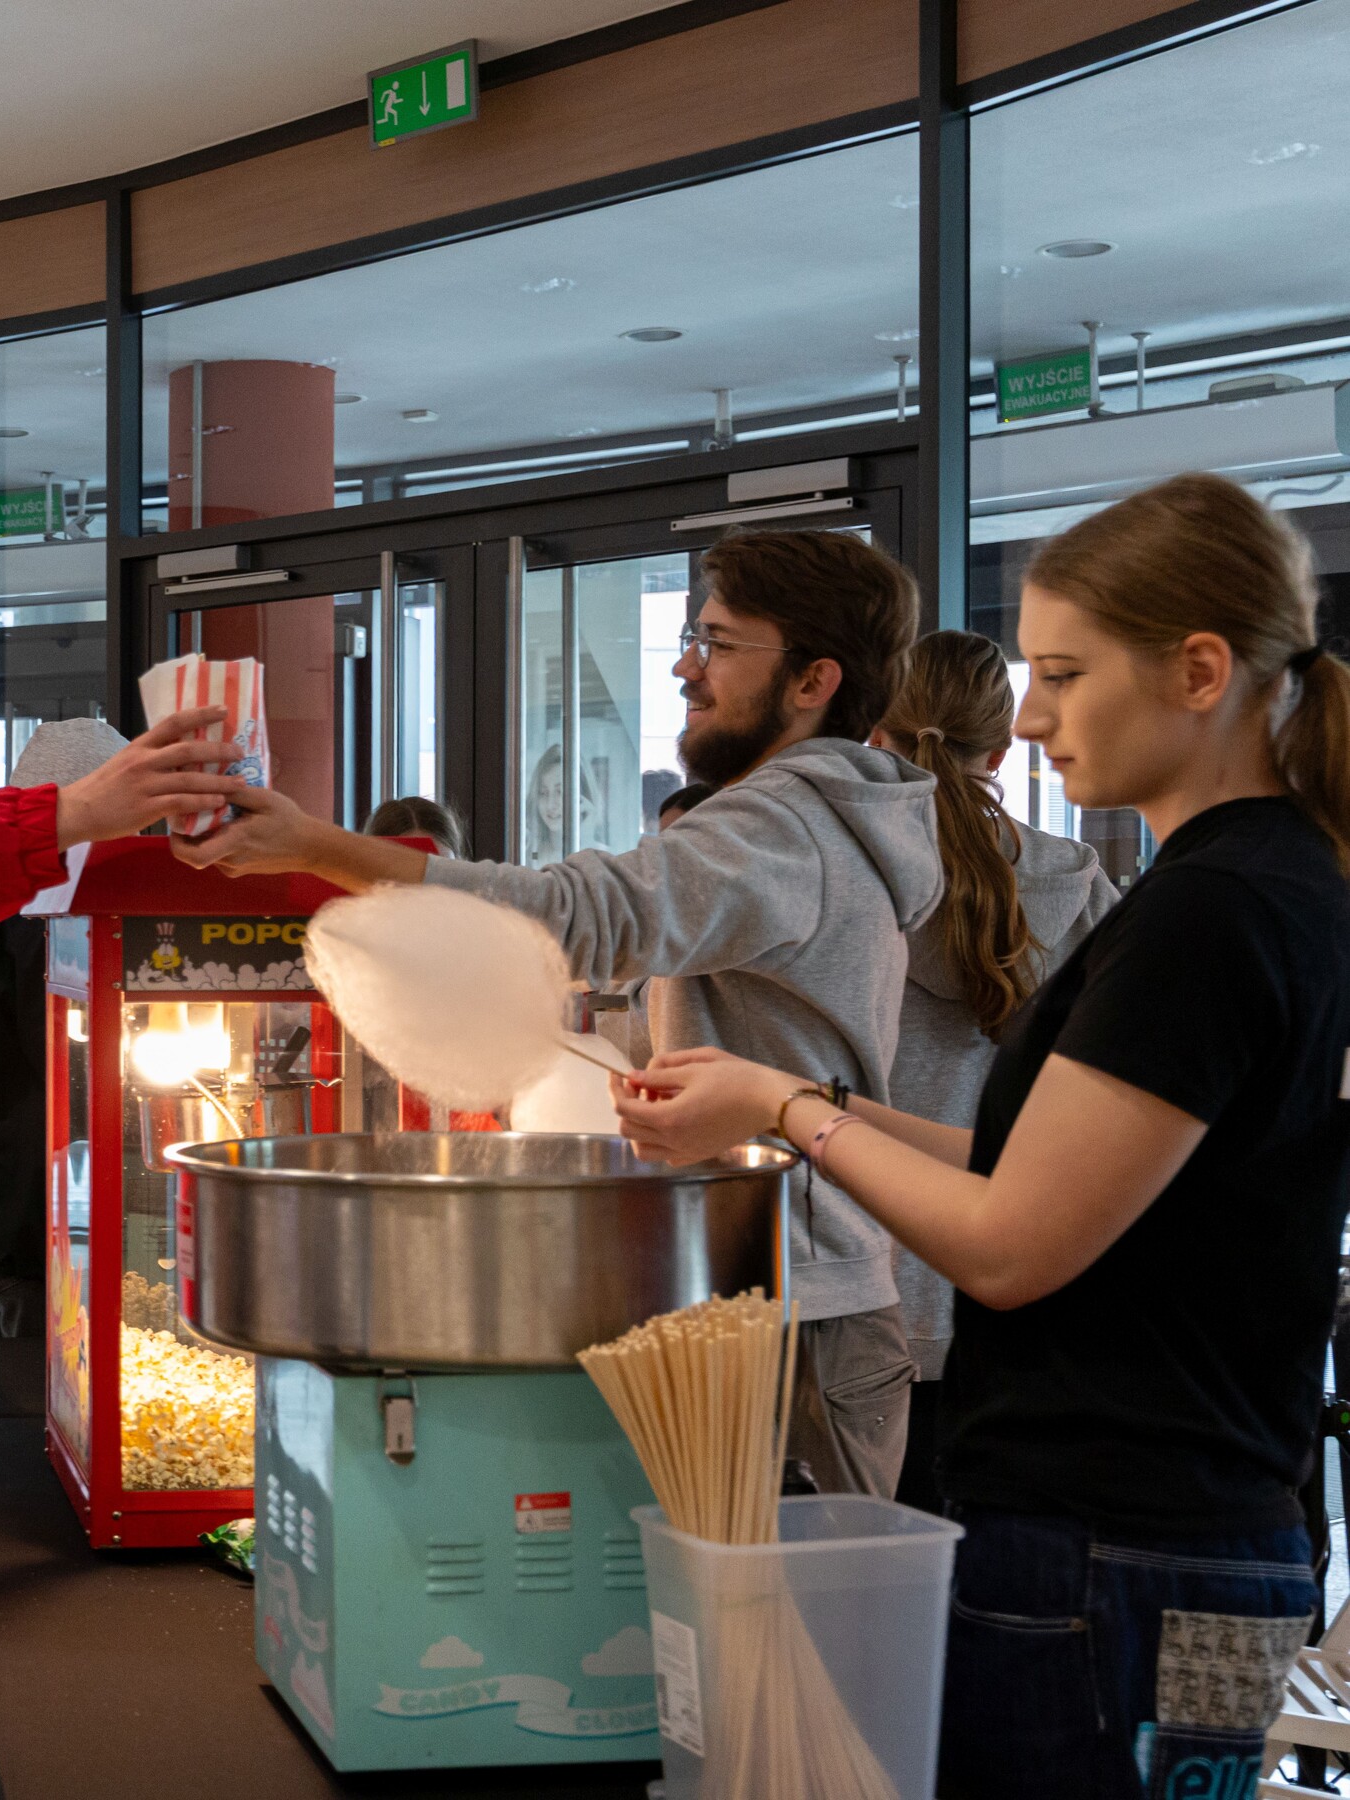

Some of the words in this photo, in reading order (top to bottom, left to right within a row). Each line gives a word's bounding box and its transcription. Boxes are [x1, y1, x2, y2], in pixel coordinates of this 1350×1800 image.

[1008, 366, 1083, 392] WYJŚCIE
[1004, 386, 1090, 411] EWAKUACYJNE
[1, 499, 55, 515] WYJŚCI
